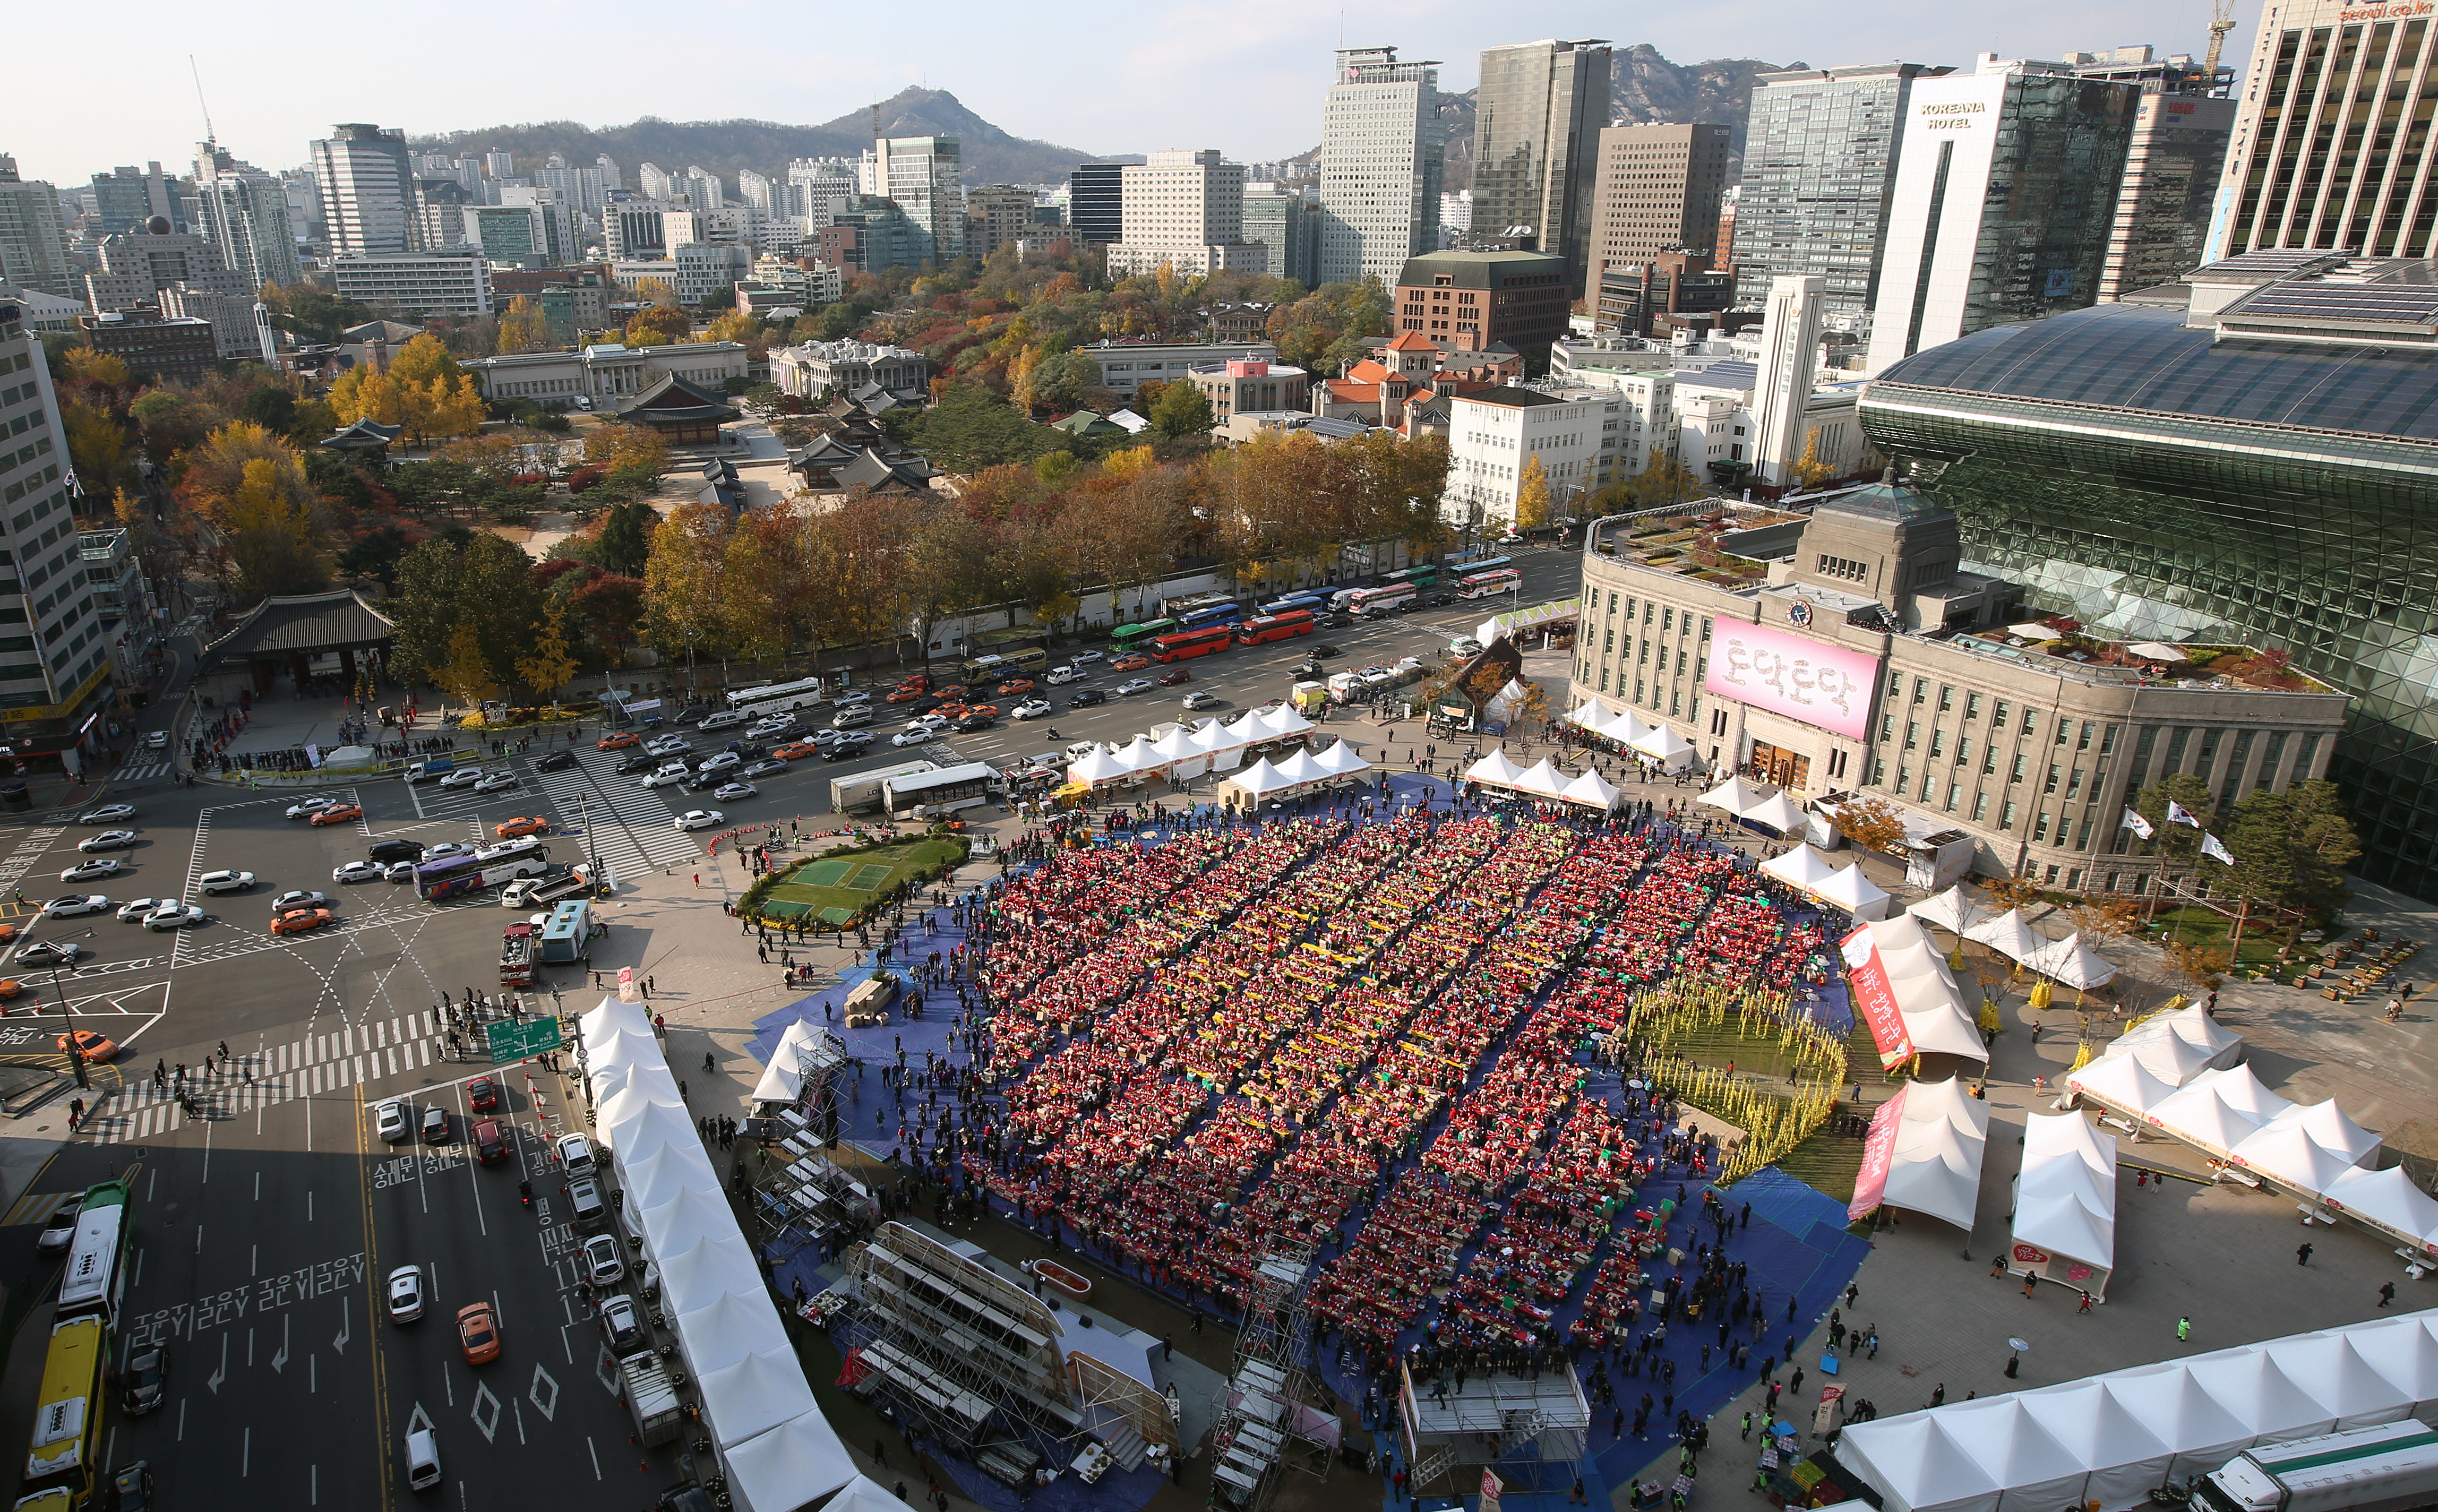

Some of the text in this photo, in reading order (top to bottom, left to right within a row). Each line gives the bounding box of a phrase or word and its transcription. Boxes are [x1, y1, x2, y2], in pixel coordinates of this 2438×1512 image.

[2338, 1, 2434, 21] seoul.co.kr
[1920, 101, 1985, 115] KOREANA
[1927, 117, 1971, 130] HOTEL
[424, 1141, 466, 1175] 숭례문
[373, 1155, 416, 1190] 숭례문
